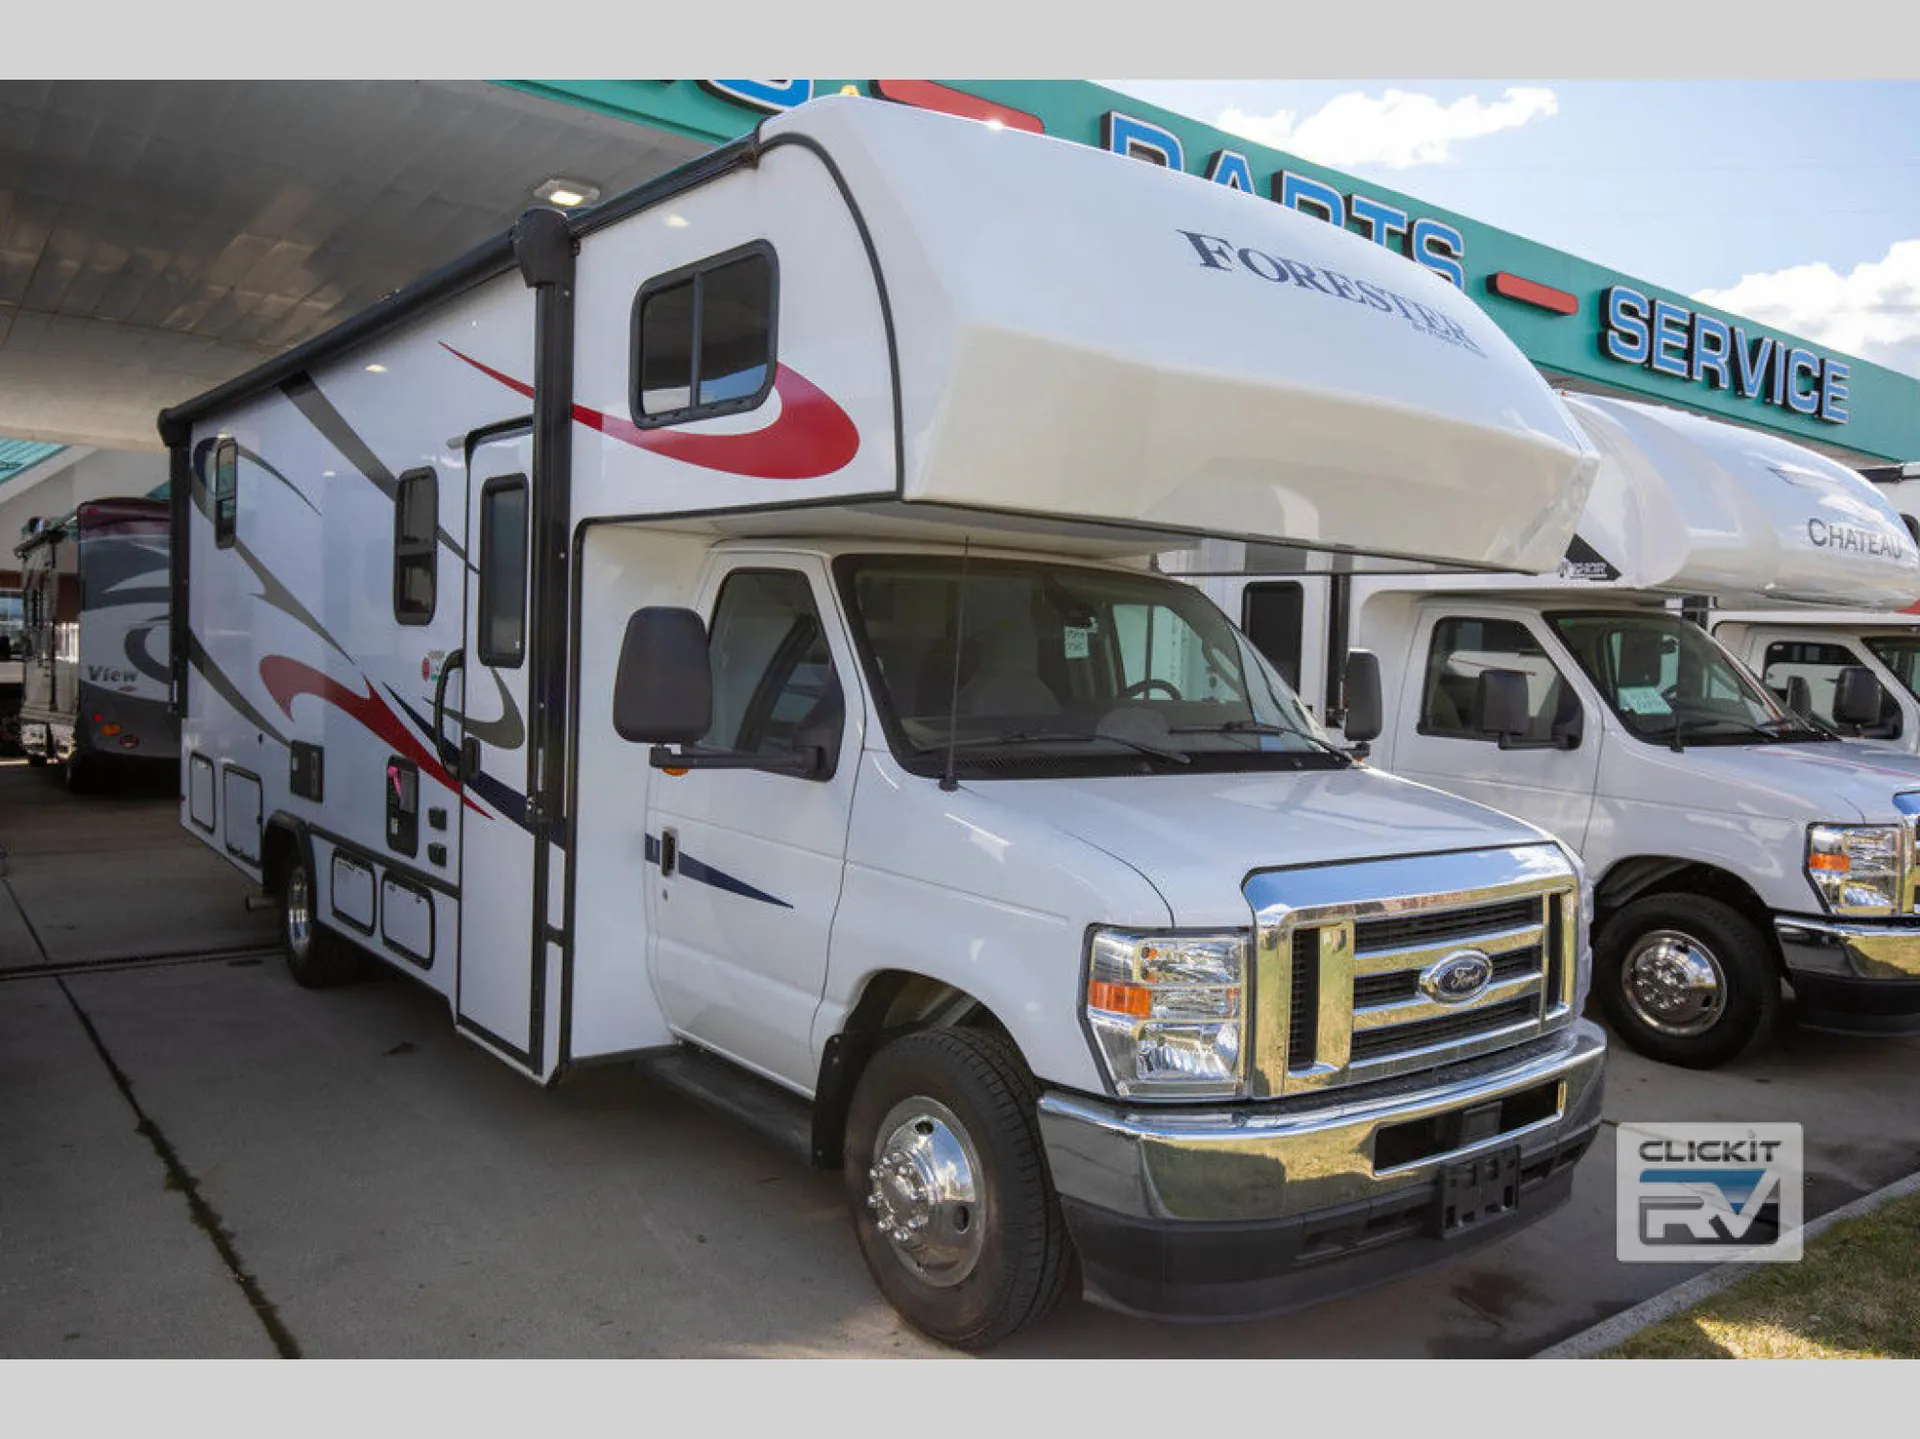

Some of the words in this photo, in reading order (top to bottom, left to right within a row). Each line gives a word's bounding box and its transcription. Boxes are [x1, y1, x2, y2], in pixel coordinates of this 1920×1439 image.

[1175, 229, 1481, 350] FORESTER
[1604, 284, 1851, 424] SERVICE
[1807, 517, 1903, 558] CHATEAU
[88, 664, 138, 682] View
